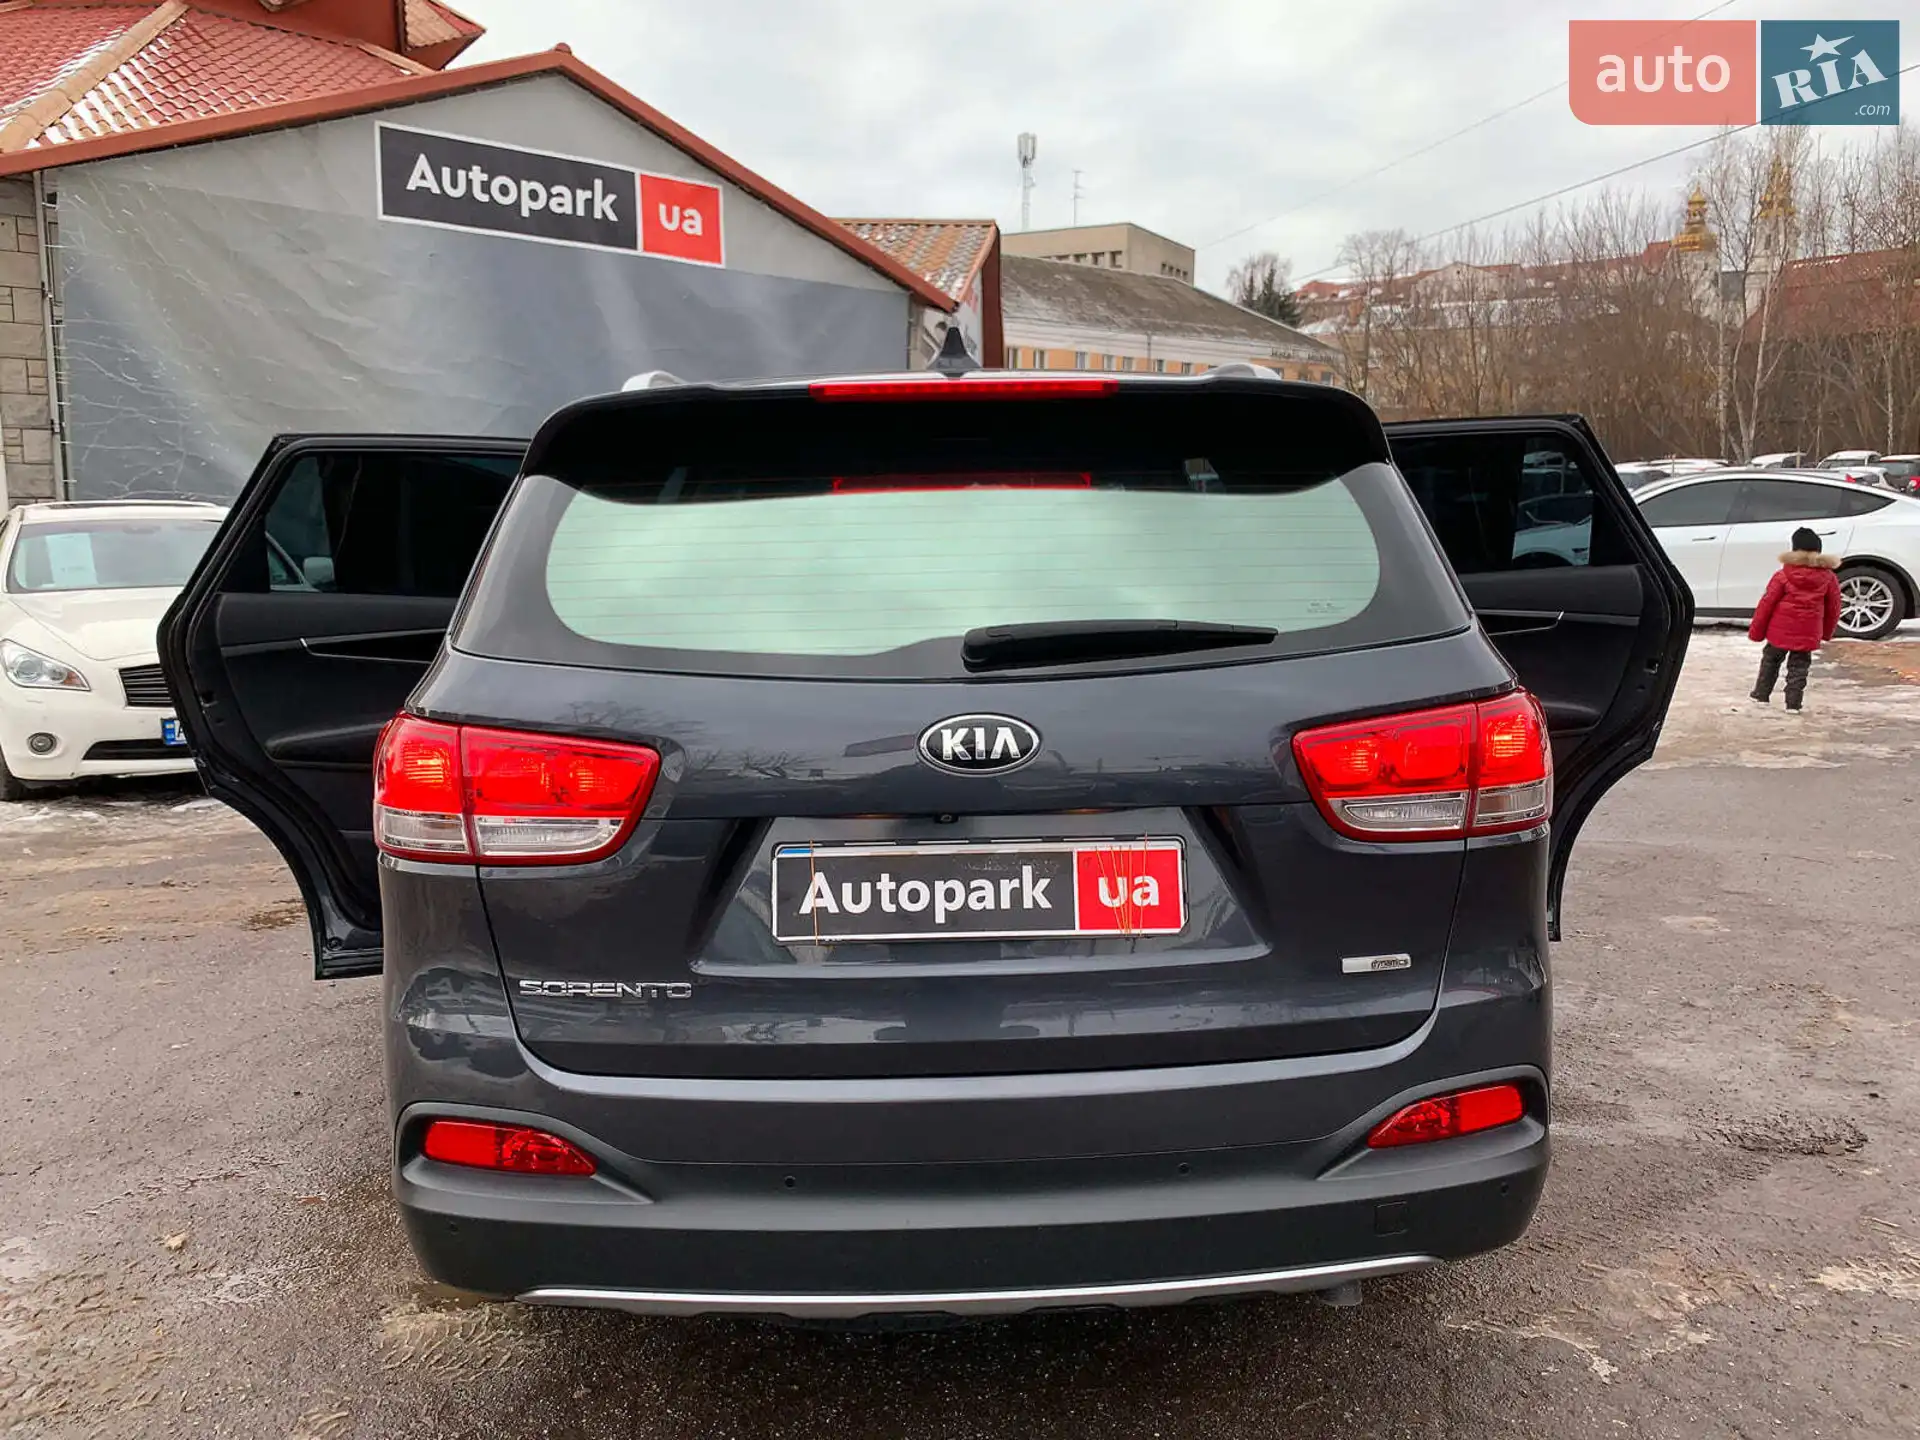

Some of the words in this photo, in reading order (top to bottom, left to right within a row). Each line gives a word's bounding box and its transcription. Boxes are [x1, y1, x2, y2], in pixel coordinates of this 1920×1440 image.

[405, 152, 619, 222] Autopark
[658, 202, 703, 236] ua
[940, 726, 1021, 761] KIA
[798, 864, 1053, 924] Autopark
[1097, 874, 1160, 908] ua
[518, 979, 692, 999] SORENTO
